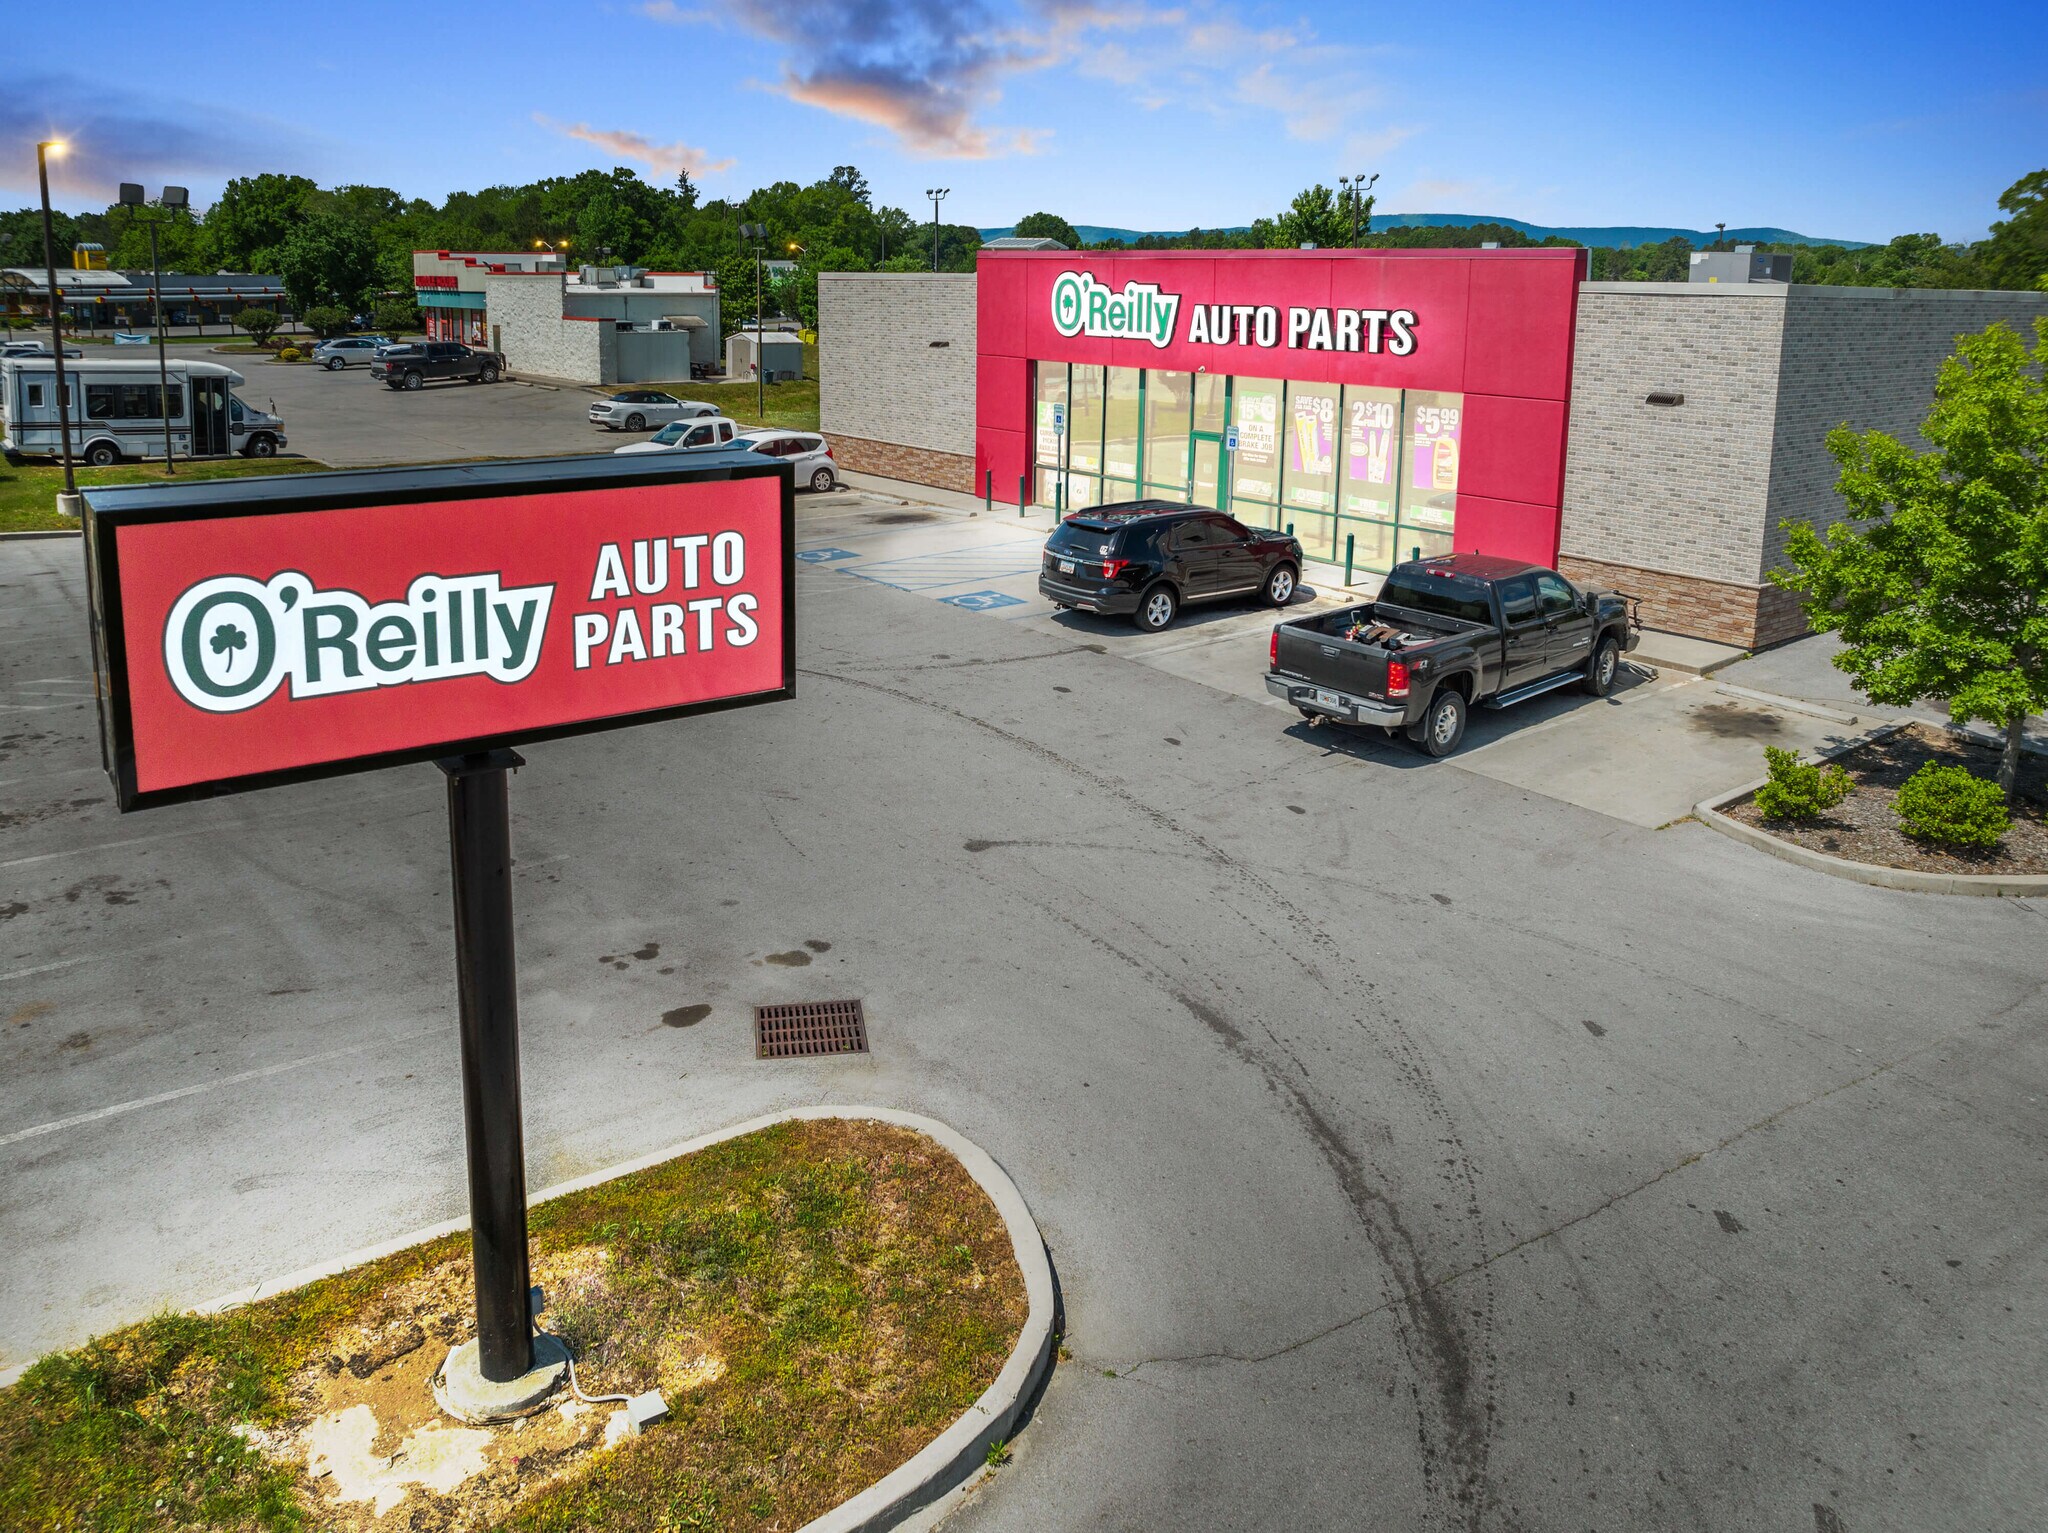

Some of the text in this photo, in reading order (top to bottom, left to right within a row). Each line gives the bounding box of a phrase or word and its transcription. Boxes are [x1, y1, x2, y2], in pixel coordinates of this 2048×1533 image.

[1054, 276, 1419, 356] O'Reilly AUTO PARTS
[1295, 395, 1334, 423] SAVE $8
[1240, 432, 1273, 443] COMPLETE
[1248, 424, 1258, 432] ON
[1259, 425, 1264, 433] A
[1238, 439, 1274, 451] BRAKE JOB
[176, 529, 746, 706] O'Reilly AUTO
[572, 592, 760, 671] PARTS
